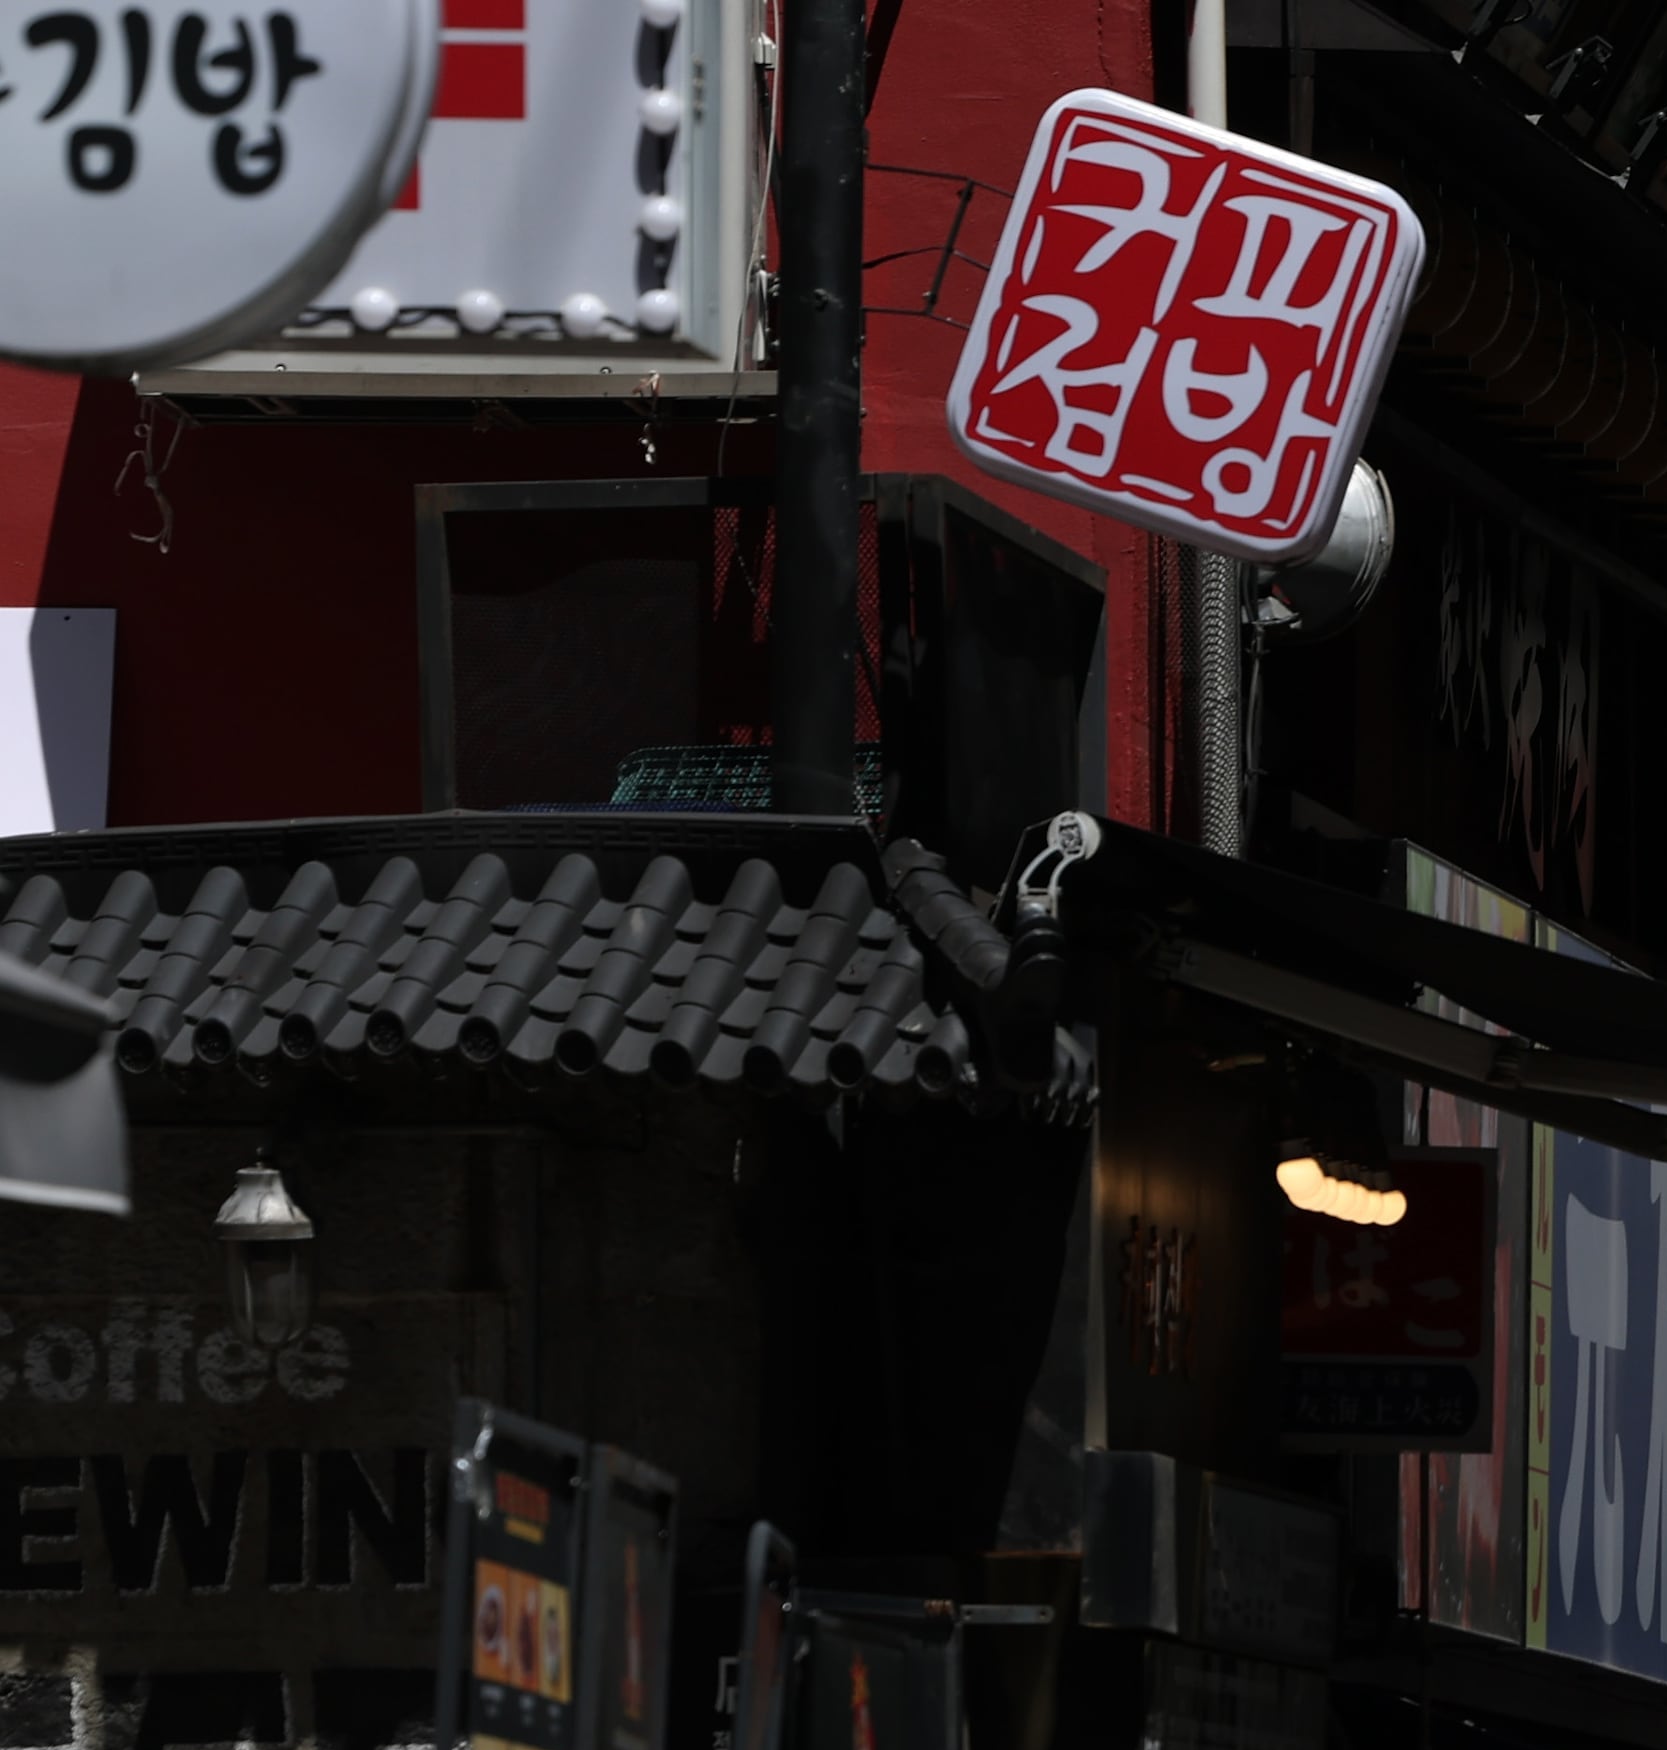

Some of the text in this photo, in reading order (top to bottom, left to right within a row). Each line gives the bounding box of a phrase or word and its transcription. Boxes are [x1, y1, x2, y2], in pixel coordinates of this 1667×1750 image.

[0, 11, 320, 194] 김밥
[1044, 138, 1365, 368] 커피
[990, 294, 1336, 521] 점방
[0, 1296, 352, 1404] offee
